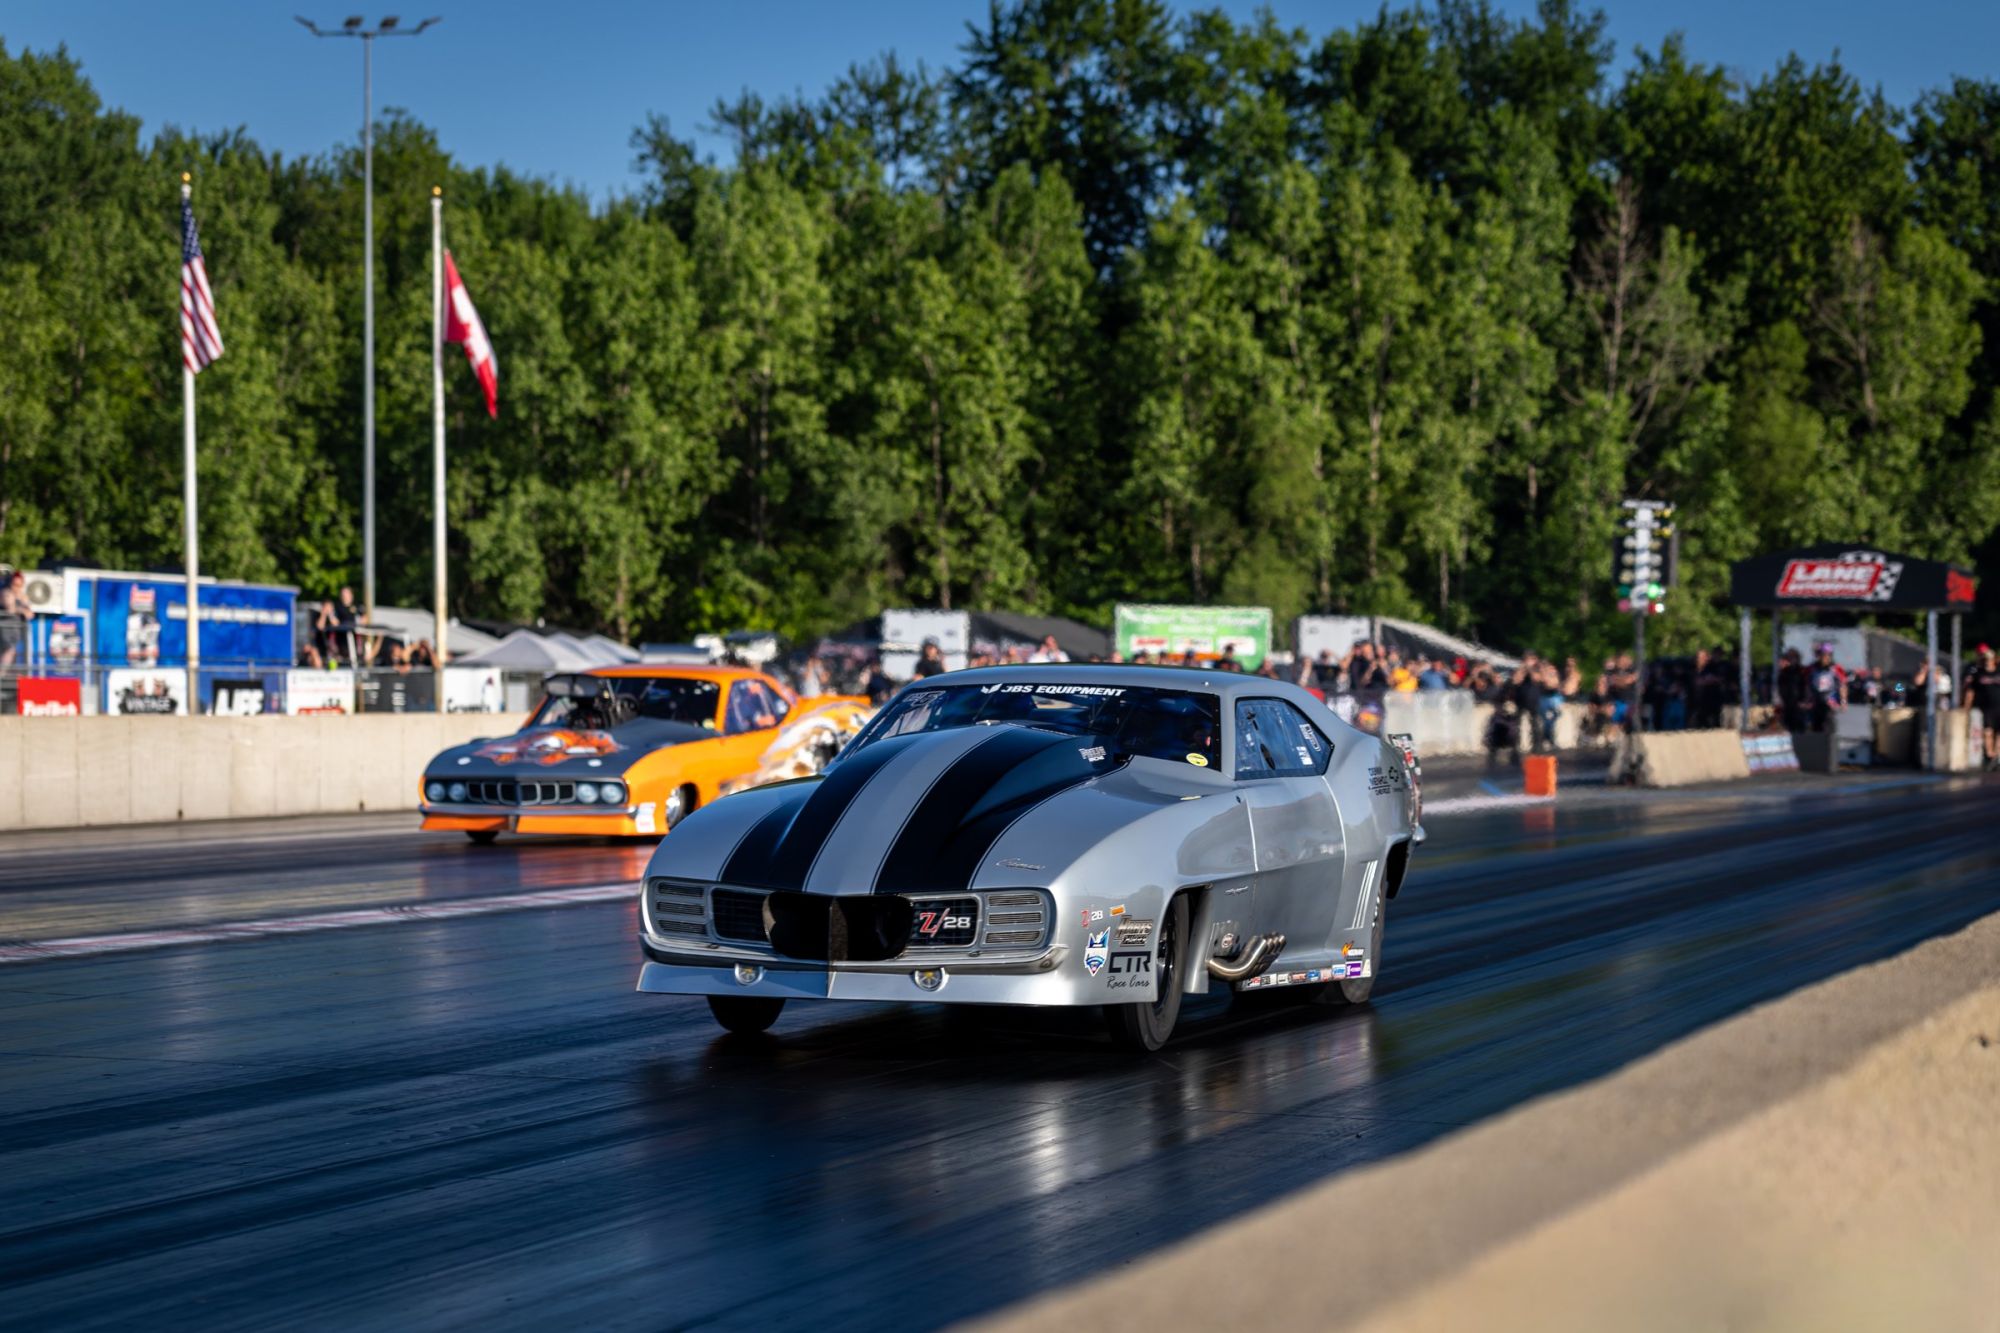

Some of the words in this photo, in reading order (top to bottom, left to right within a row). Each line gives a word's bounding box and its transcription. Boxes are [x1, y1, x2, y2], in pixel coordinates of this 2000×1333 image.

[1794, 565, 1877, 580] LANE
[1001, 684, 1034, 693] JBS
[1035, 684, 1127, 697] EQUIPMENT
[125, 697, 171, 712] VINTAGE
[919, 907, 972, 938] Z/28
[1108, 951, 1151, 973] CTR
[1106, 976, 1130, 990] Race
[1130, 974, 1151, 988] Cars
